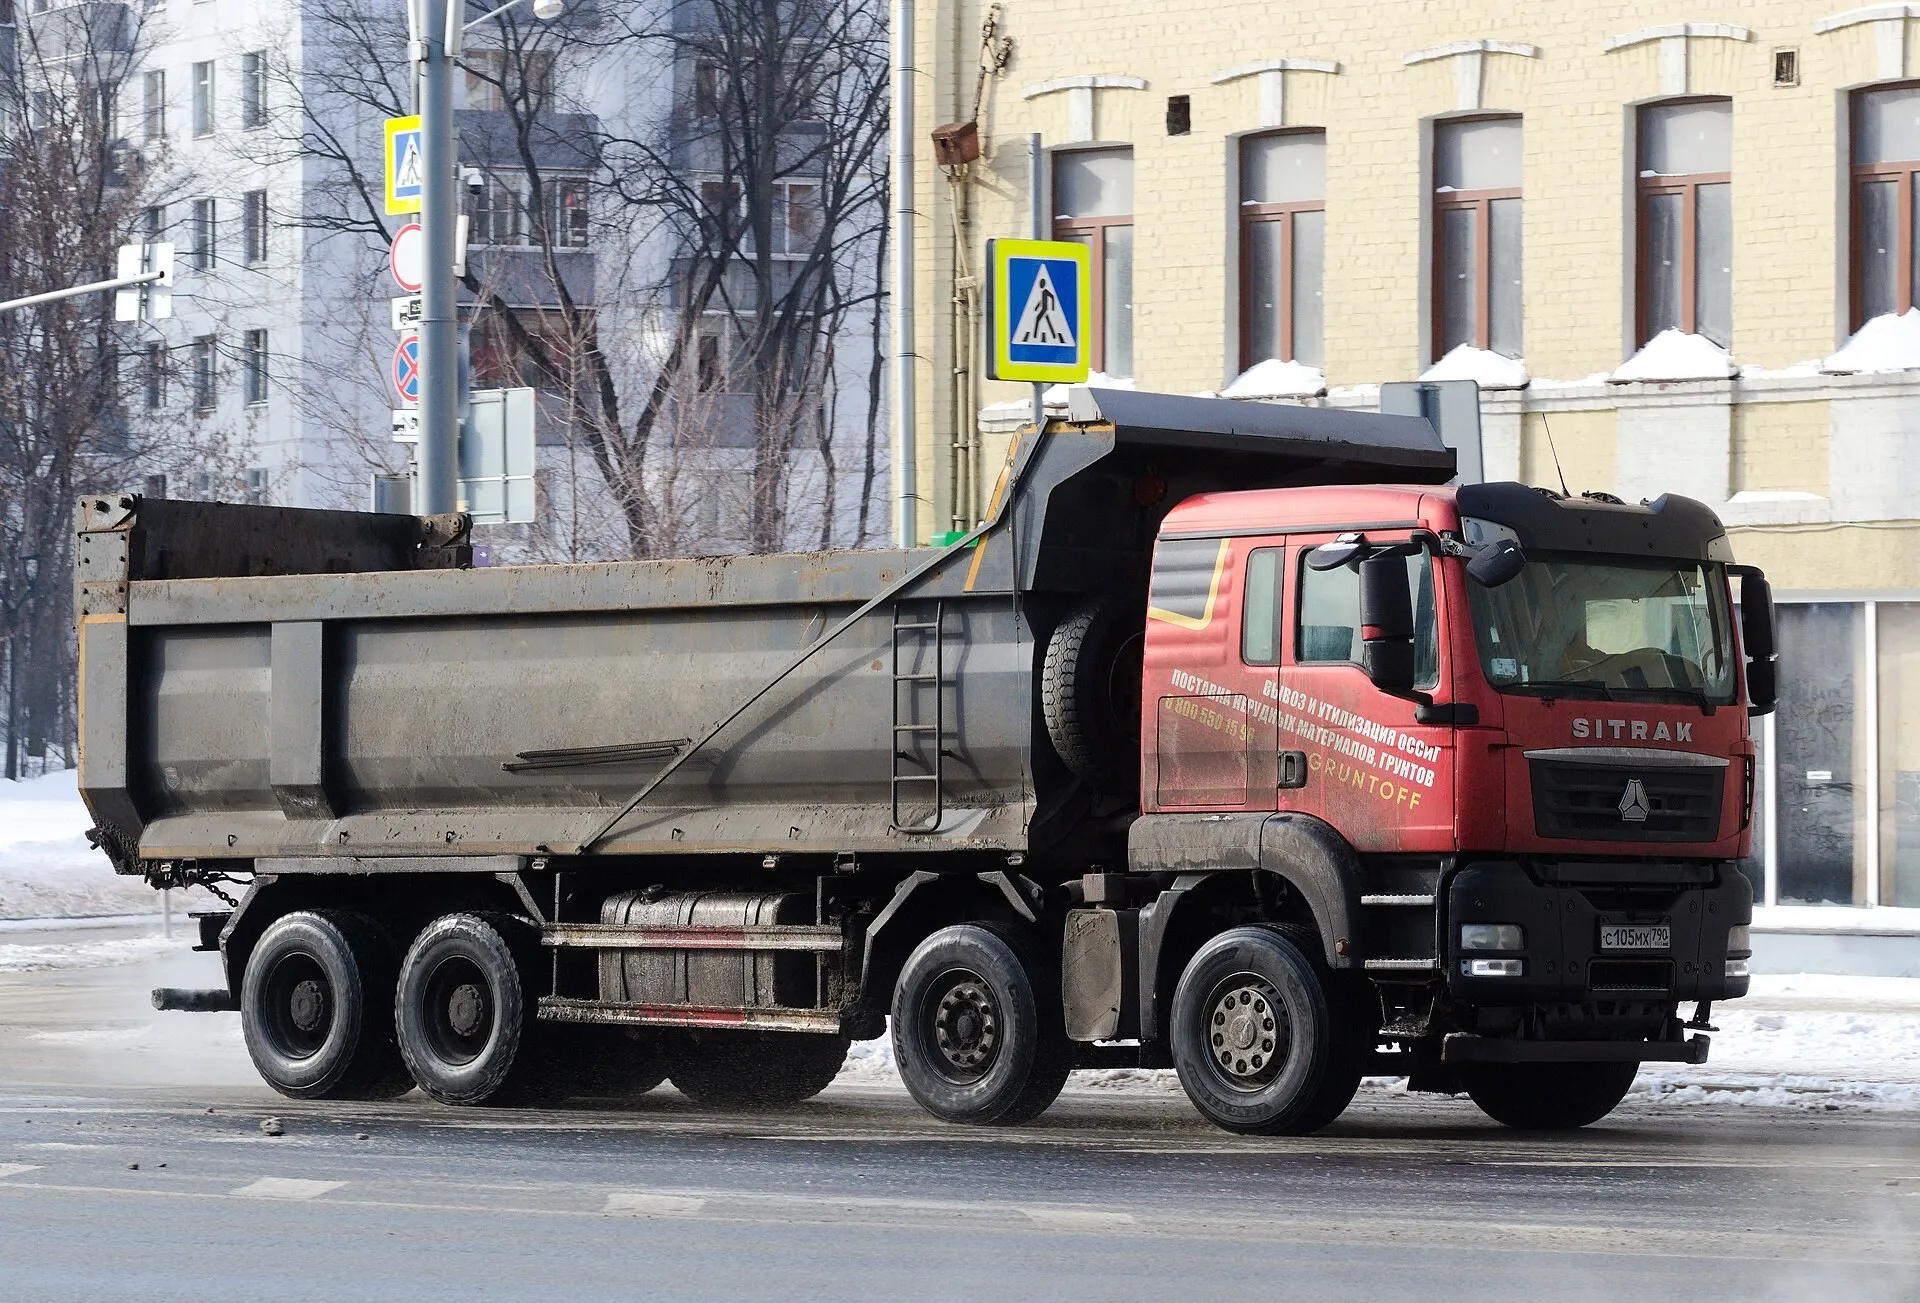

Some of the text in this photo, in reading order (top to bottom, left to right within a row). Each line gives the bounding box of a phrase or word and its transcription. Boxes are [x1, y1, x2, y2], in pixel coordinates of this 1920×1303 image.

[1171, 668, 1435, 787] ПОСТАВКА НЕРУДНЫХ МАТЕРИАЛОВ, ГРУНТОВ
[1174, 697, 1199, 720] 800
[1200, 707, 1224, 730] 550
[1262, 679, 1307, 711] ВЫВОЗ
[1307, 697, 1318, 715] И
[1317, 701, 1397, 747] УТИЛИЗАЦИЯ
[1572, 718, 1693, 742] SITRAK
[1309, 752, 1422, 810] GRUNTOFF
[1651, 928, 1668, 941] 790
